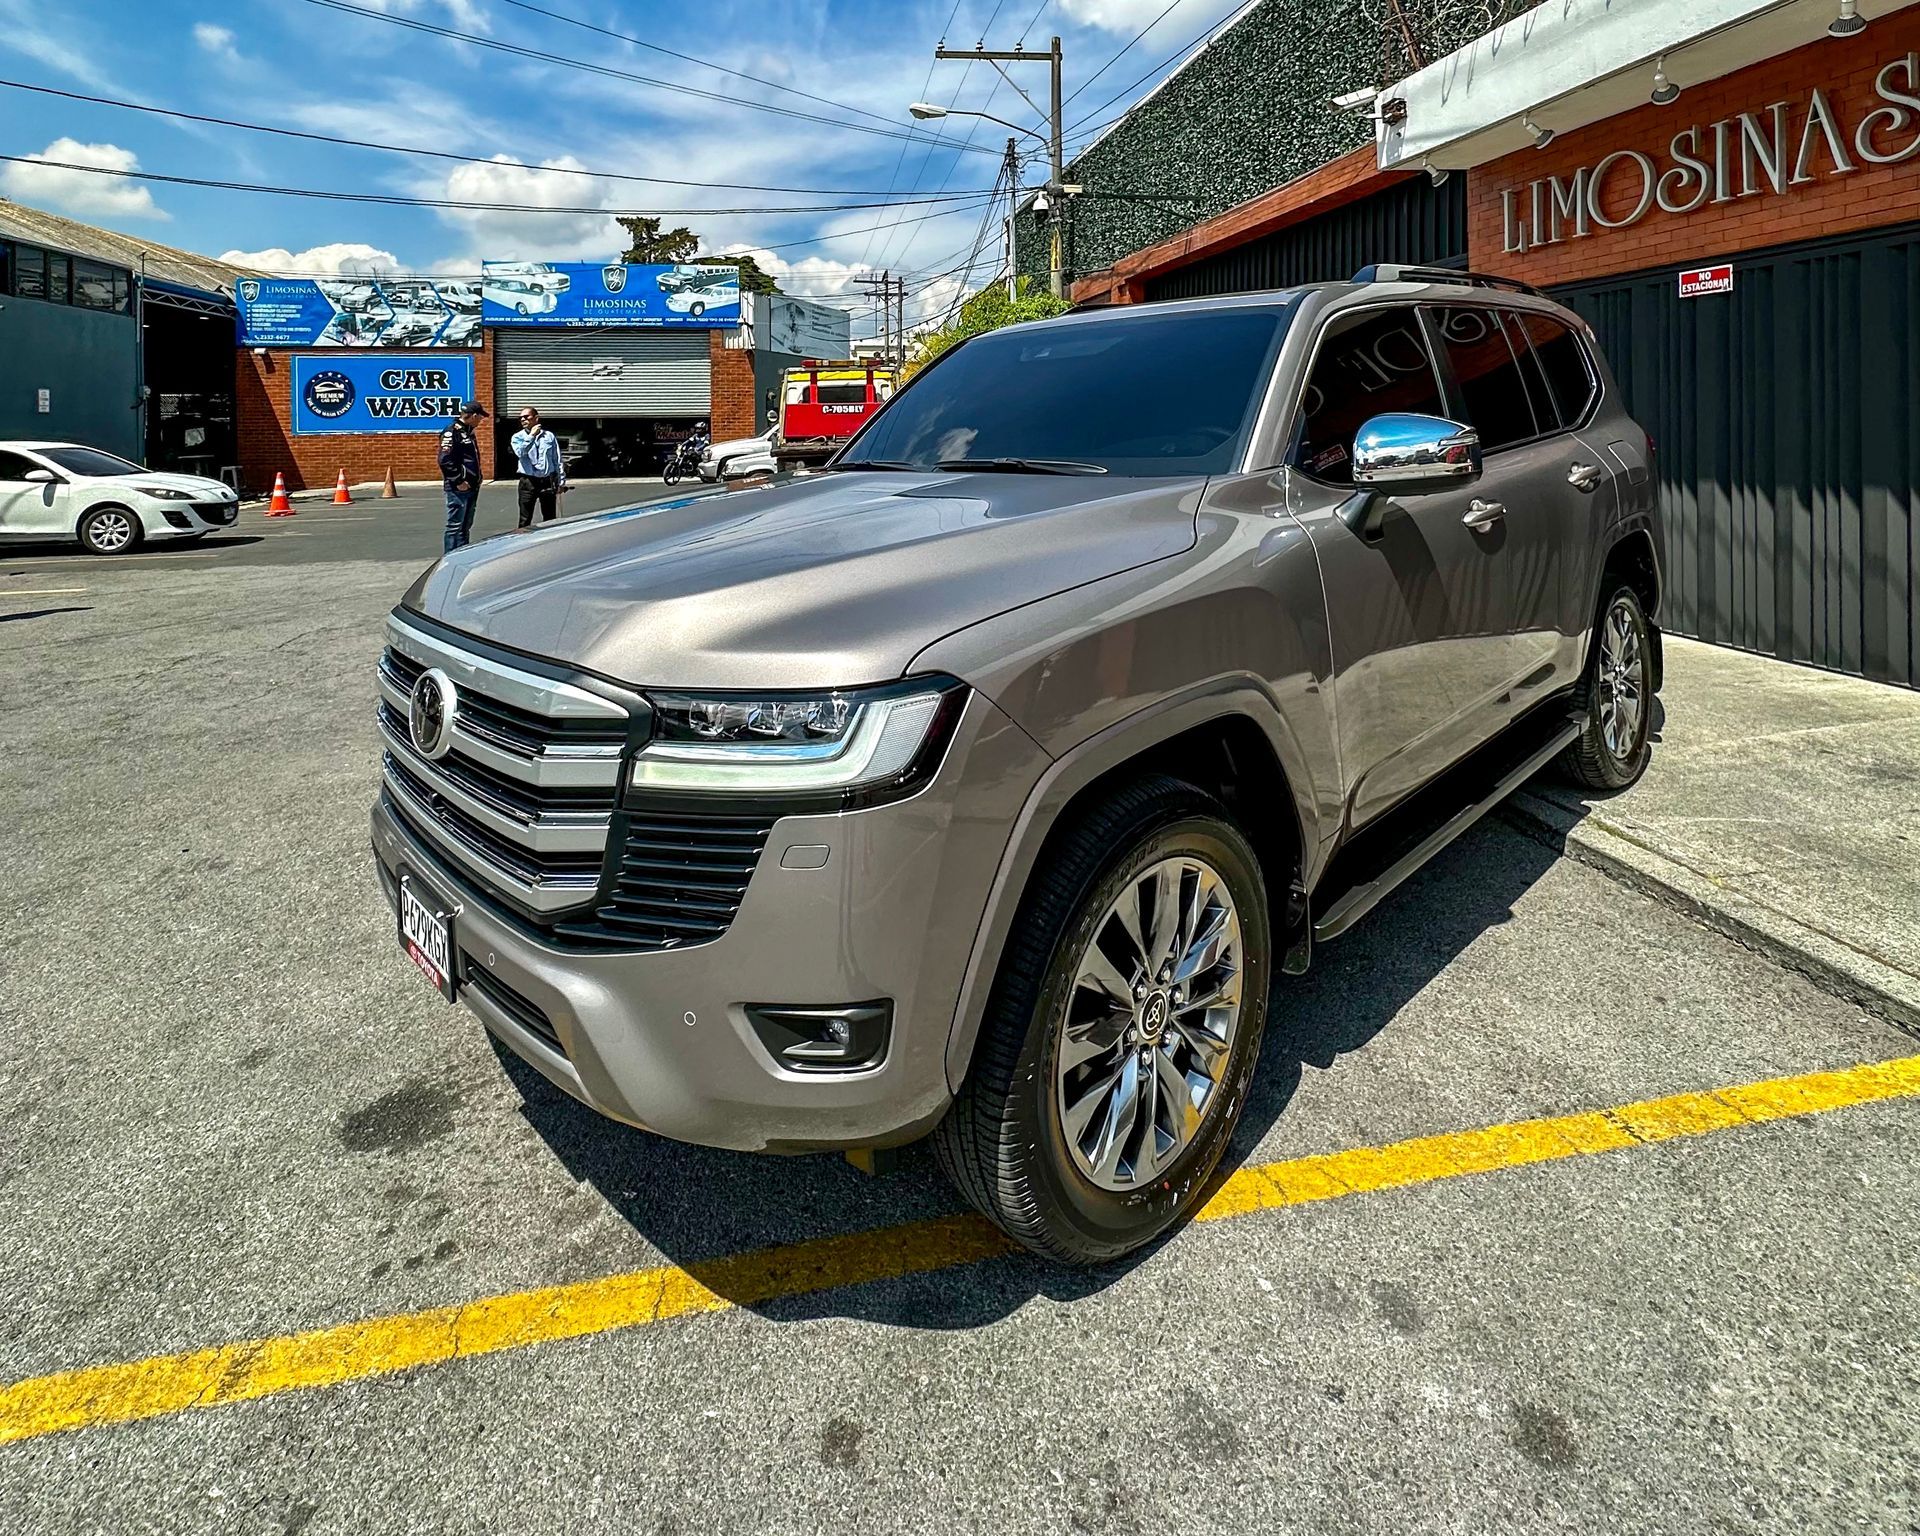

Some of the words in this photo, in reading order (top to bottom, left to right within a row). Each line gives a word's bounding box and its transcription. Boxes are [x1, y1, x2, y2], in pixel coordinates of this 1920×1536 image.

[1500, 52, 1920, 254] LIMOSINAS
[1698, 271, 1712, 281] NO
[266, 285, 317, 294] LIMOSINAS
[1682, 278, 1729, 293] ESTACIONAR
[584, 298, 647, 308] LIMOSINAS
[380, 369, 449, 390] CAR
[365, 396, 462, 417] WASH
